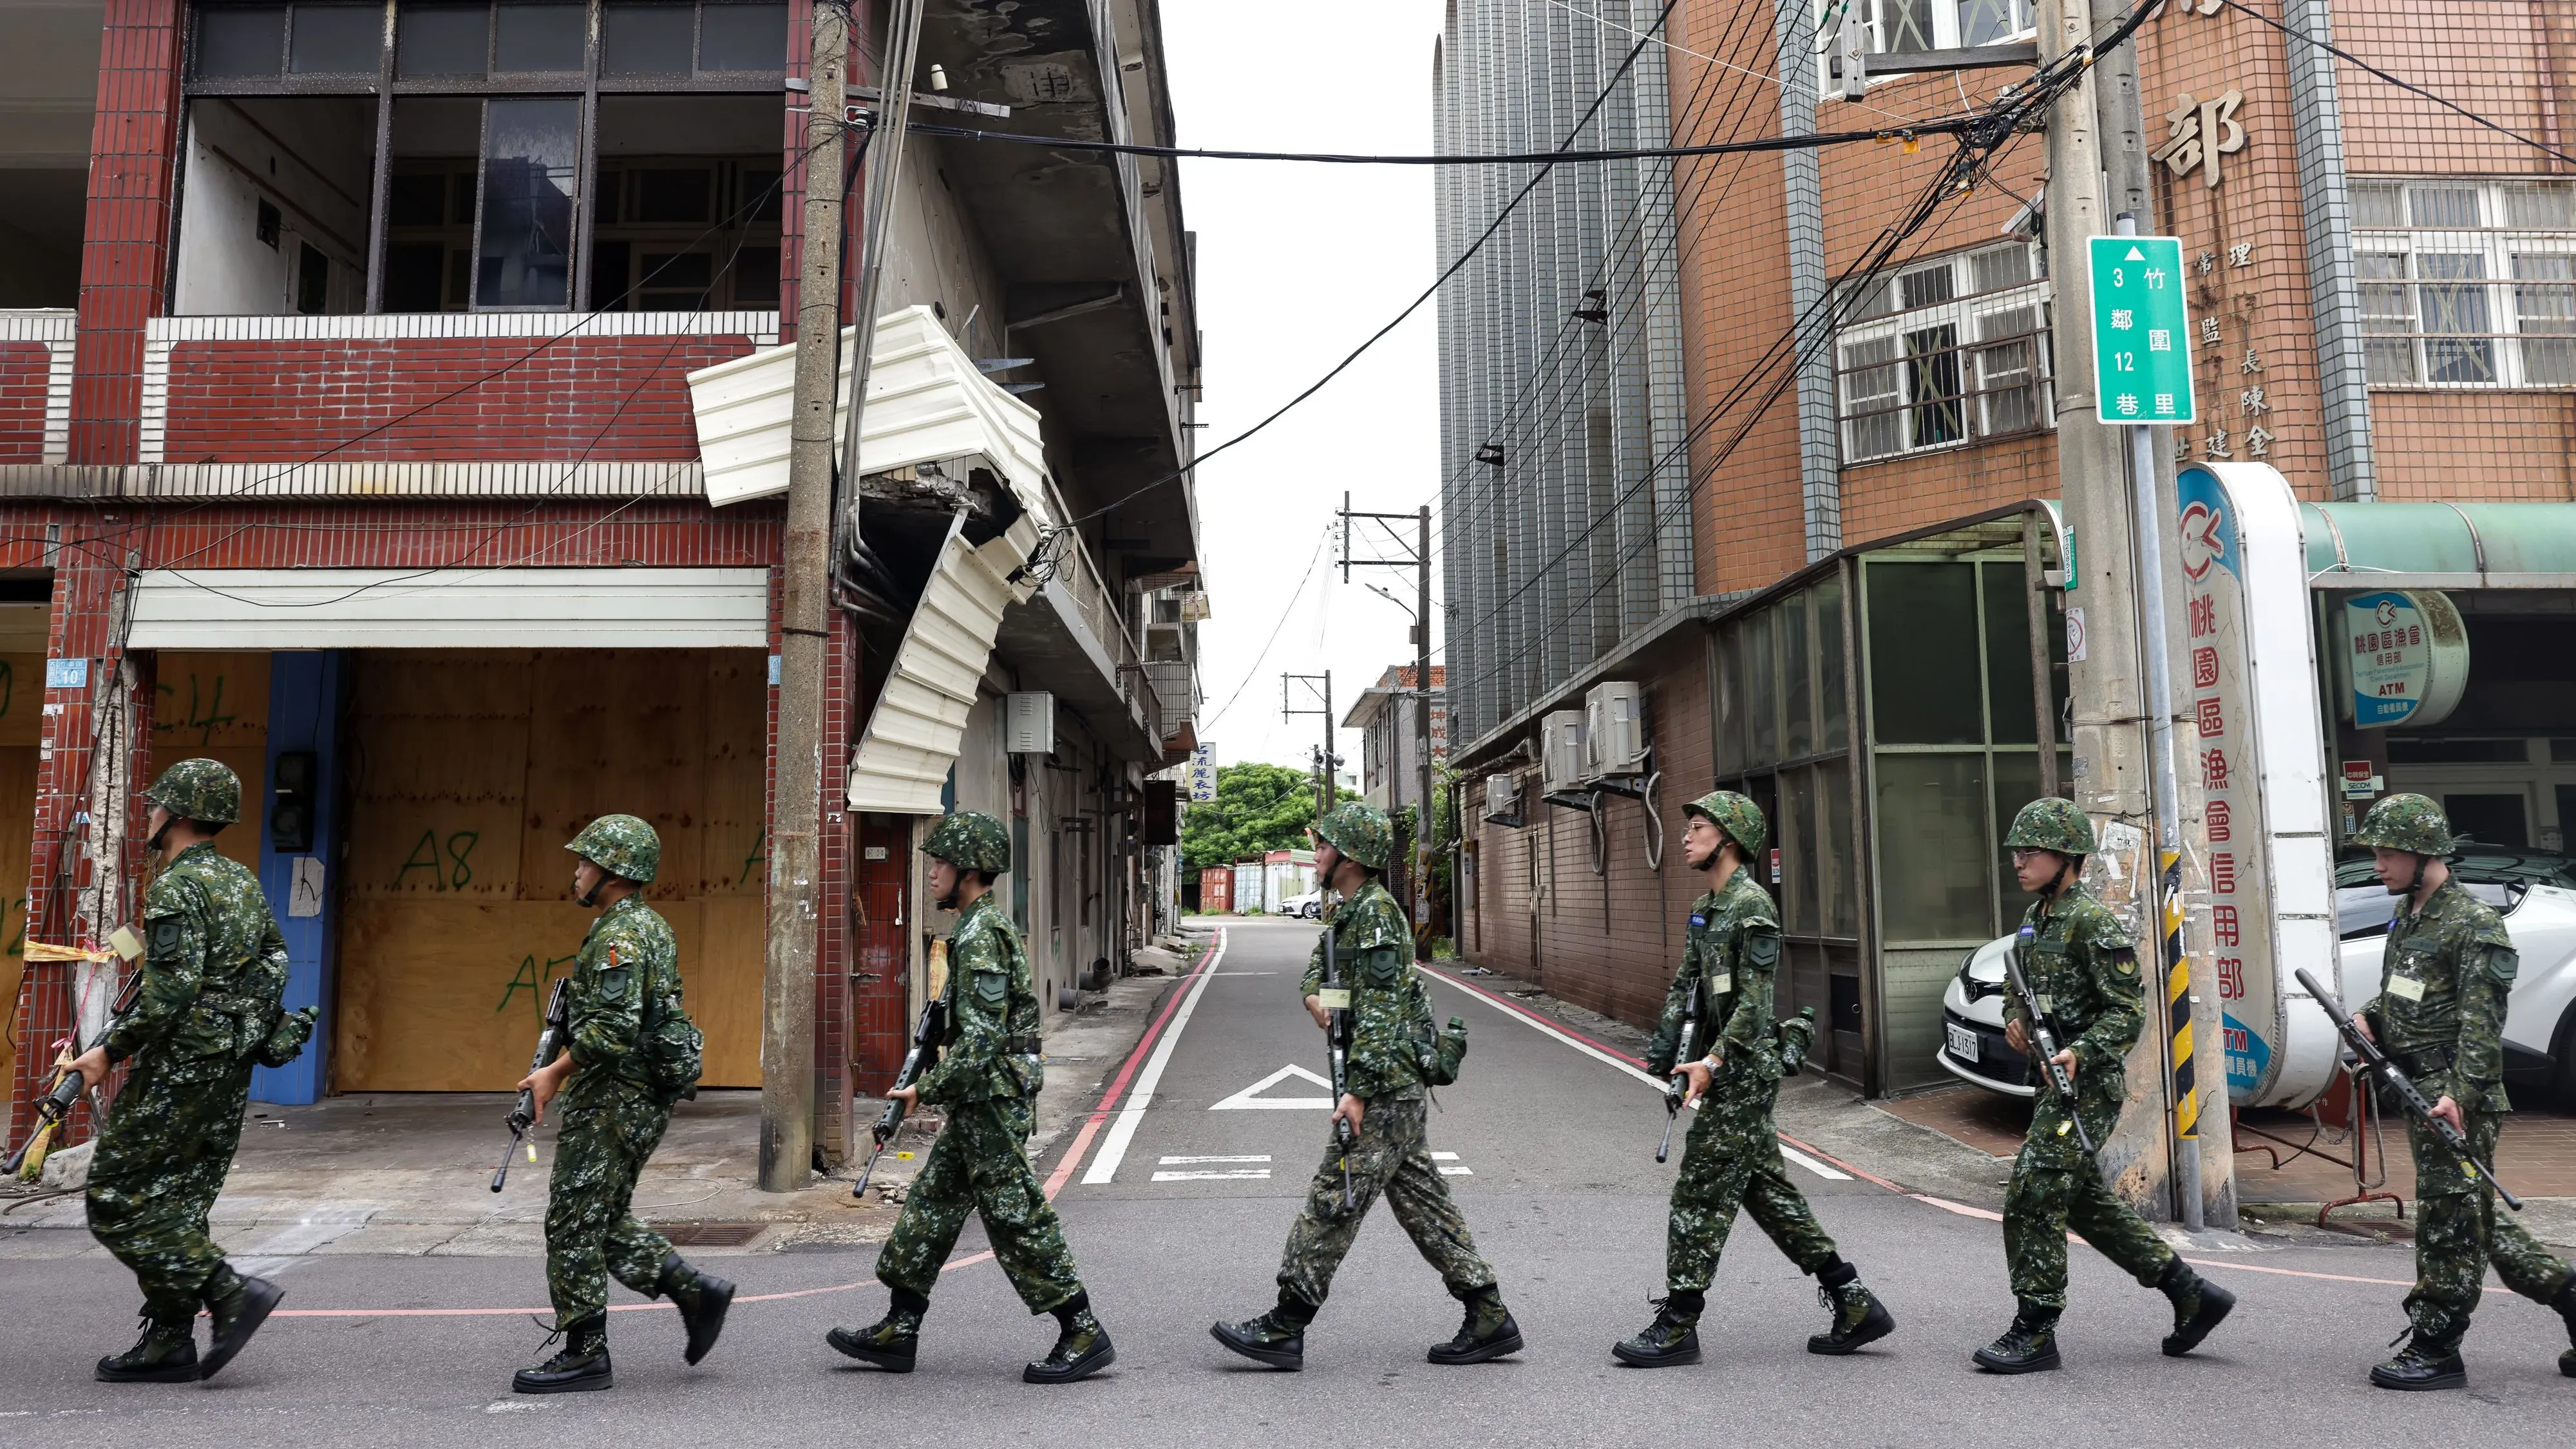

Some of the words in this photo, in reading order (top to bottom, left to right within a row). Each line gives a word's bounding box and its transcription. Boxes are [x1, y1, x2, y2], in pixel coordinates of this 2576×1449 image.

[2144, 268, 2176, 415] 竹圍里
[2354, 625, 2421, 655] 桃園區漁會
[2376, 651, 2402, 666] 信用部
[62, 670, 78, 685] 10
[2379, 682, 2405, 696] ATM
[2190, 593, 2245, 1001] 桃園區漁會信用部
[391, 829, 478, 892] A8
[1949, 1032, 1976, 1057] BLJ-1317
[2222, 1028, 2248, 1052] TM
[2224, 1055, 2257, 1078] 櫃員機
